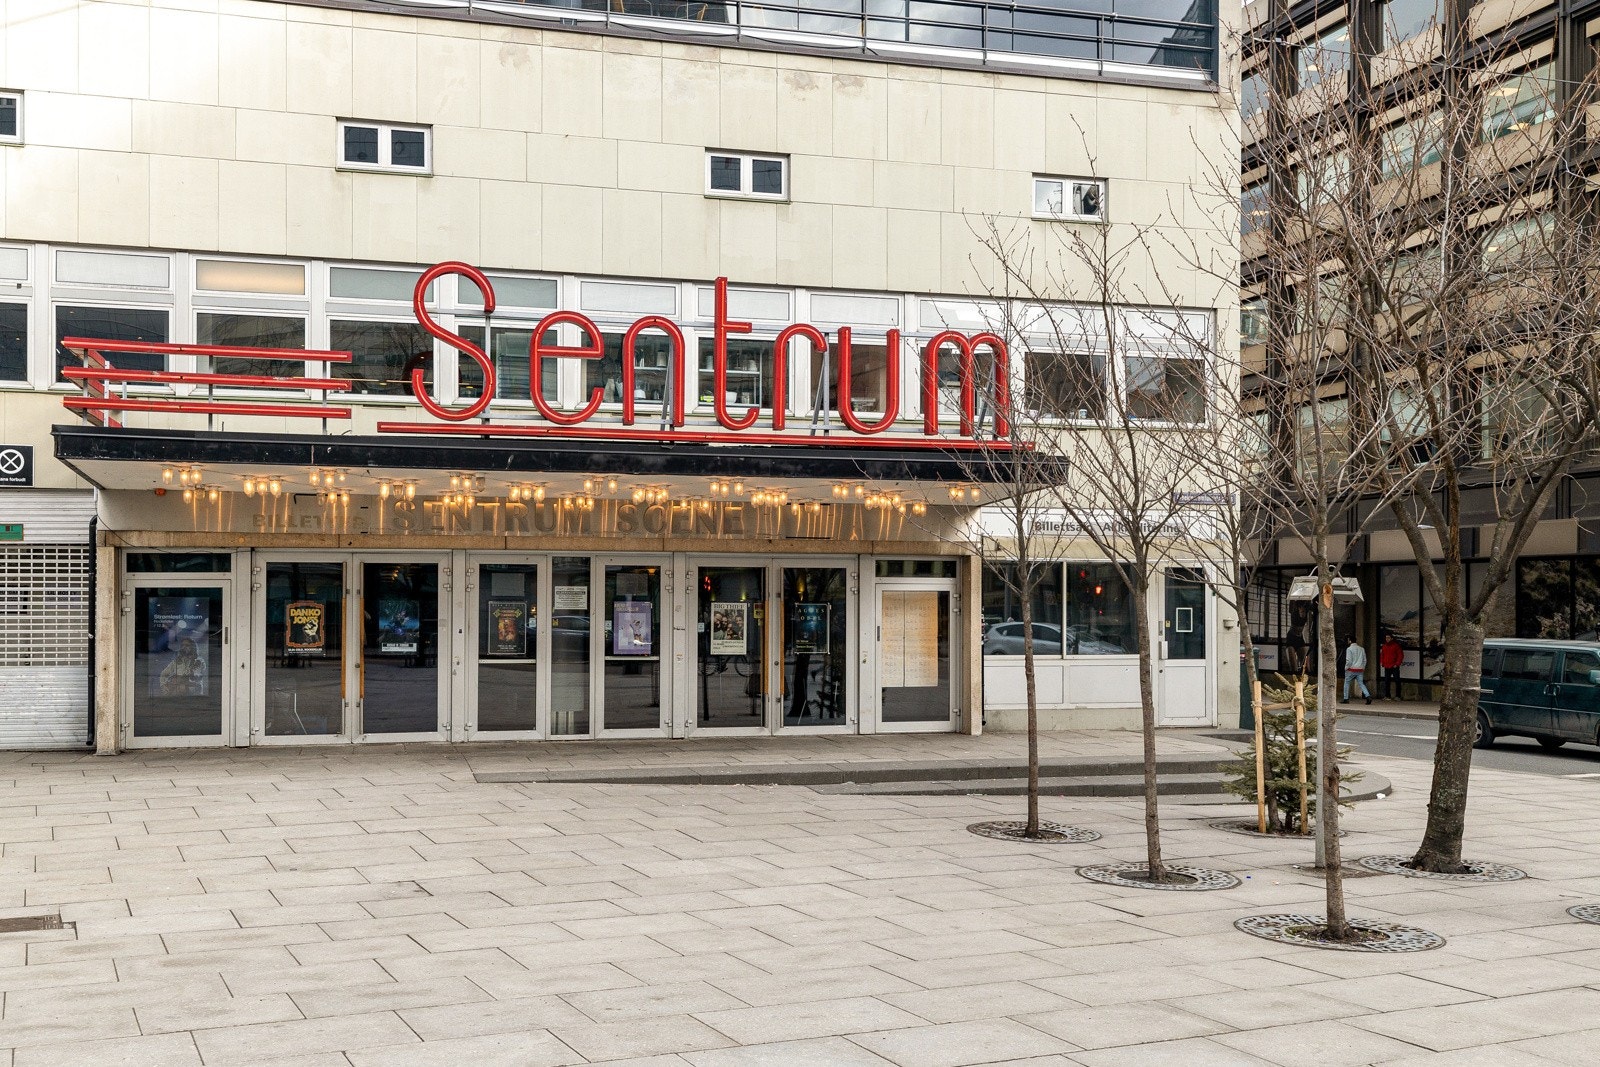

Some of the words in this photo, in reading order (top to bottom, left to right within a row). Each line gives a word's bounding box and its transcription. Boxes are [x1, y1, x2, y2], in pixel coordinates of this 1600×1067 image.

[413, 261, 1010, 437] Sentrum
[393, 500, 592, 533] SENTRUM
[617, 504, 744, 534] SCENE
[1035, 521, 1093, 533] Billettsag
[290, 608, 321, 617] DANKO
